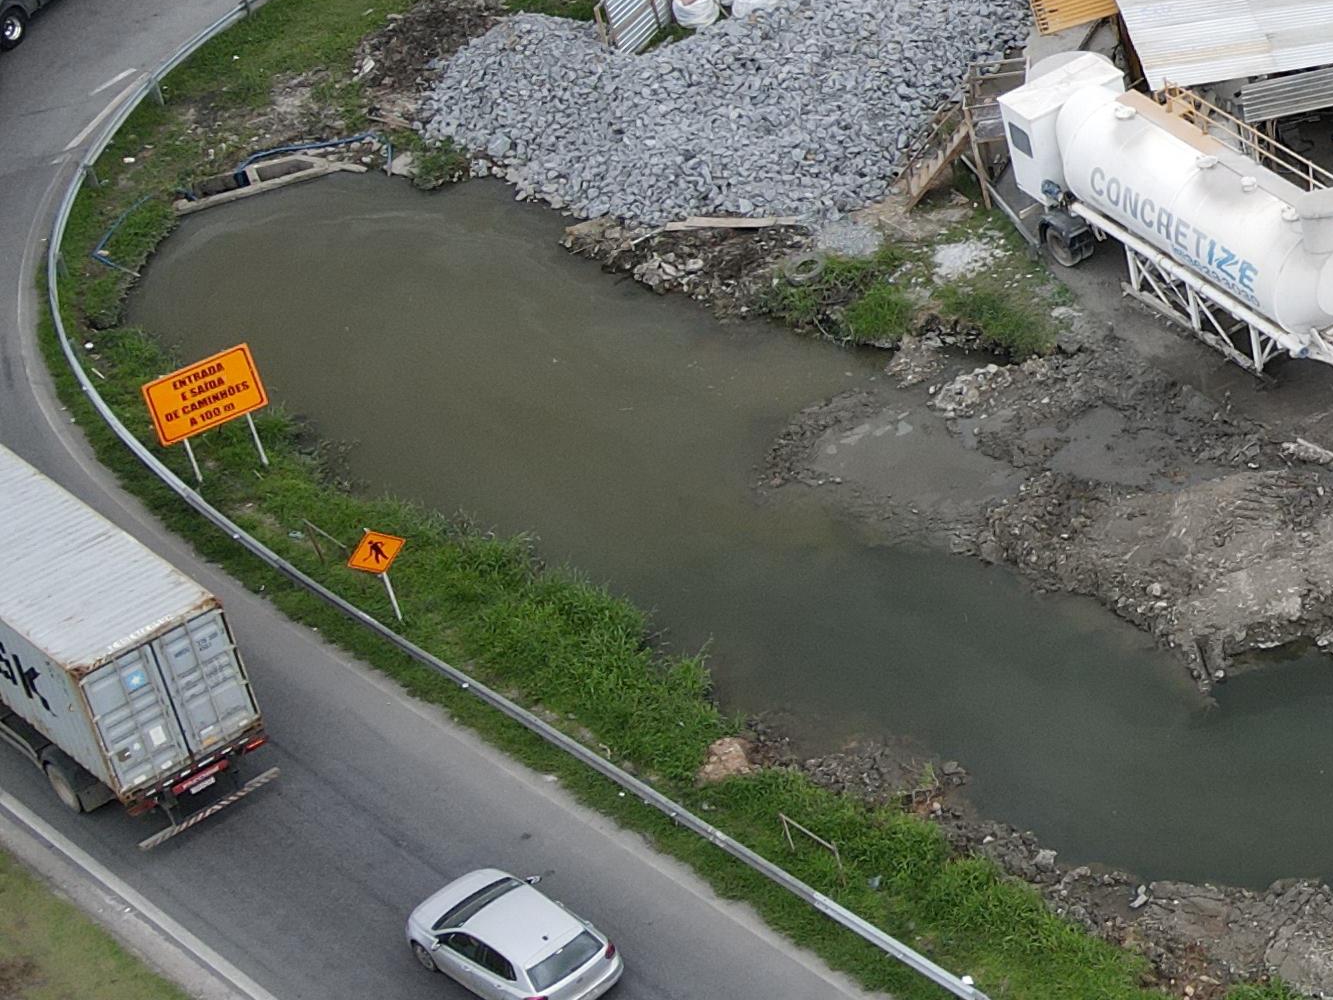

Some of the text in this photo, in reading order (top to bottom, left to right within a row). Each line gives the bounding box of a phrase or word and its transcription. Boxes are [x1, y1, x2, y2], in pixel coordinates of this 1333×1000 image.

[1090, 167, 1258, 292] CONCRETIZE
[172, 362, 225, 390] ENTRADA
[180, 377, 225, 401] E SAÍDA
[165, 381, 250, 422] DE CAMINHÕES
[189, 402, 235, 426] A 100 m
